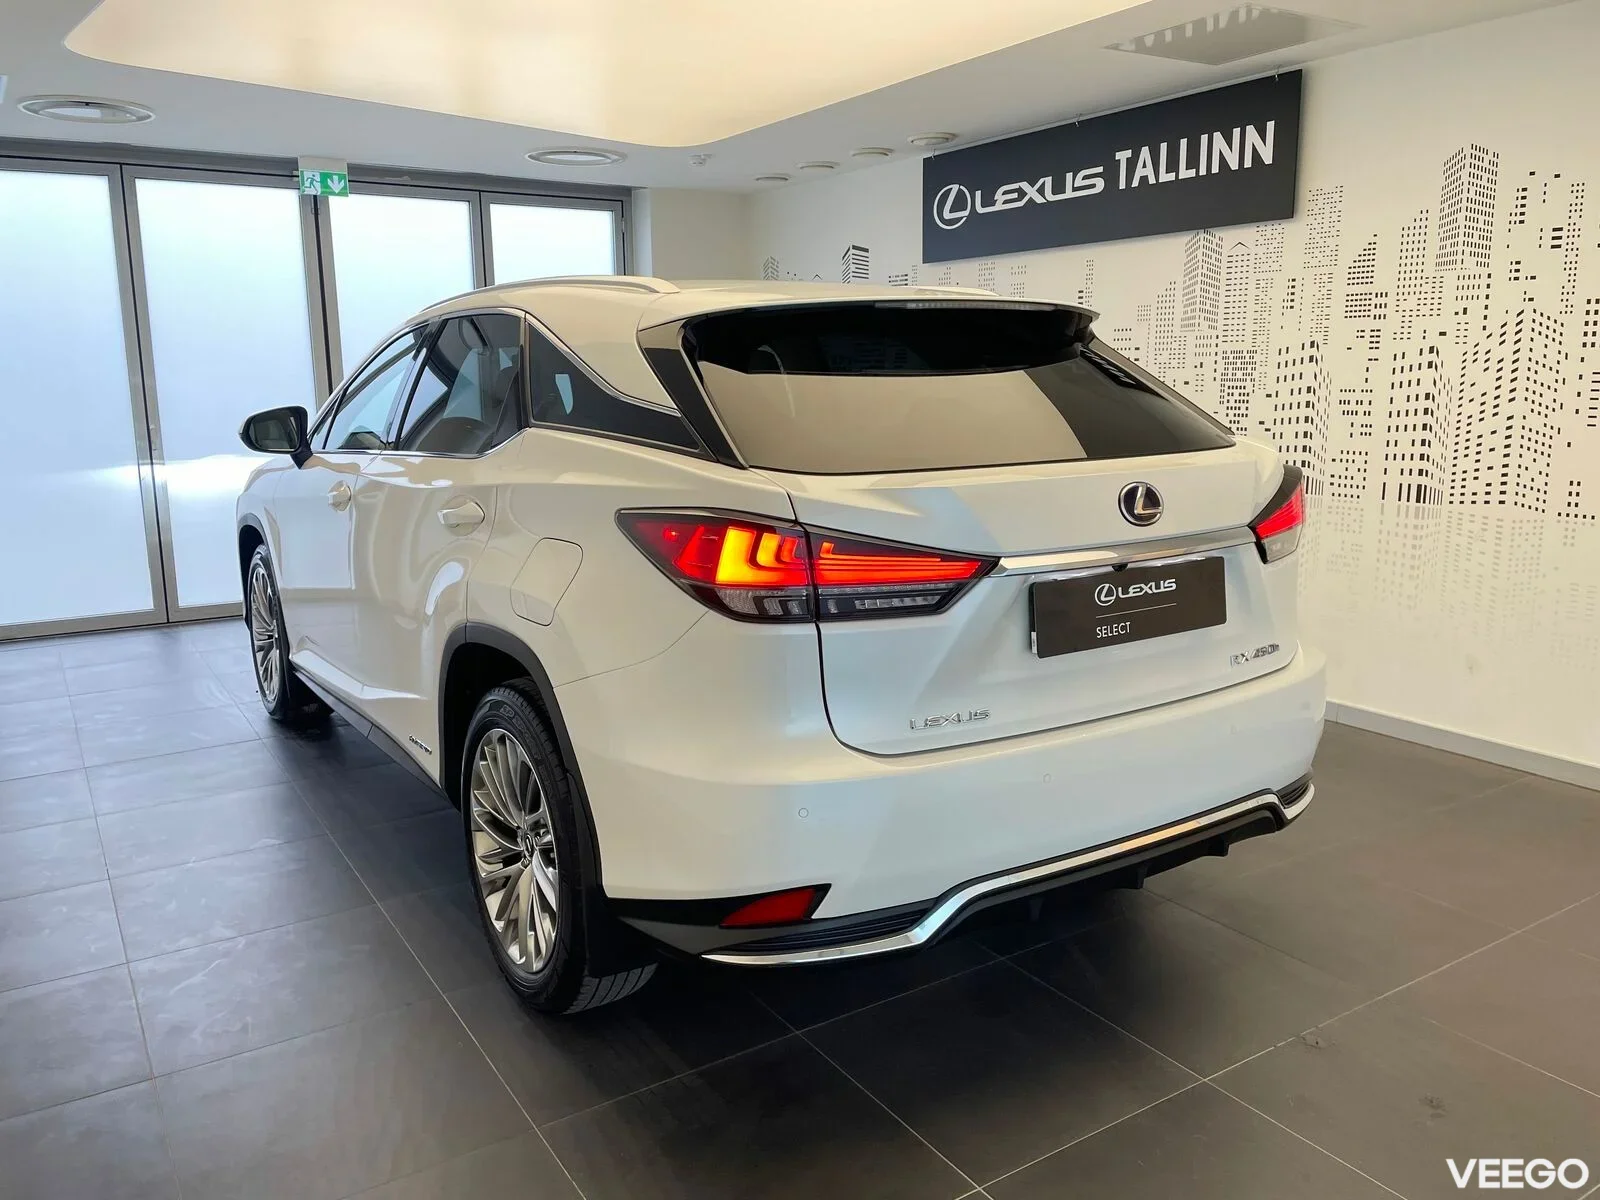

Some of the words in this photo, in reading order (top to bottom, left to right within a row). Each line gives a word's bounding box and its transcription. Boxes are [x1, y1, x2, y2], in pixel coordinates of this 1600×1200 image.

[975, 165, 1106, 214] LEXUS
[1115, 120, 1276, 190] TALLINN
[1117, 578, 1177, 599] LEXUS
[1096, 621, 1131, 639] SELECT
[909, 708, 991, 730] LEXUS
